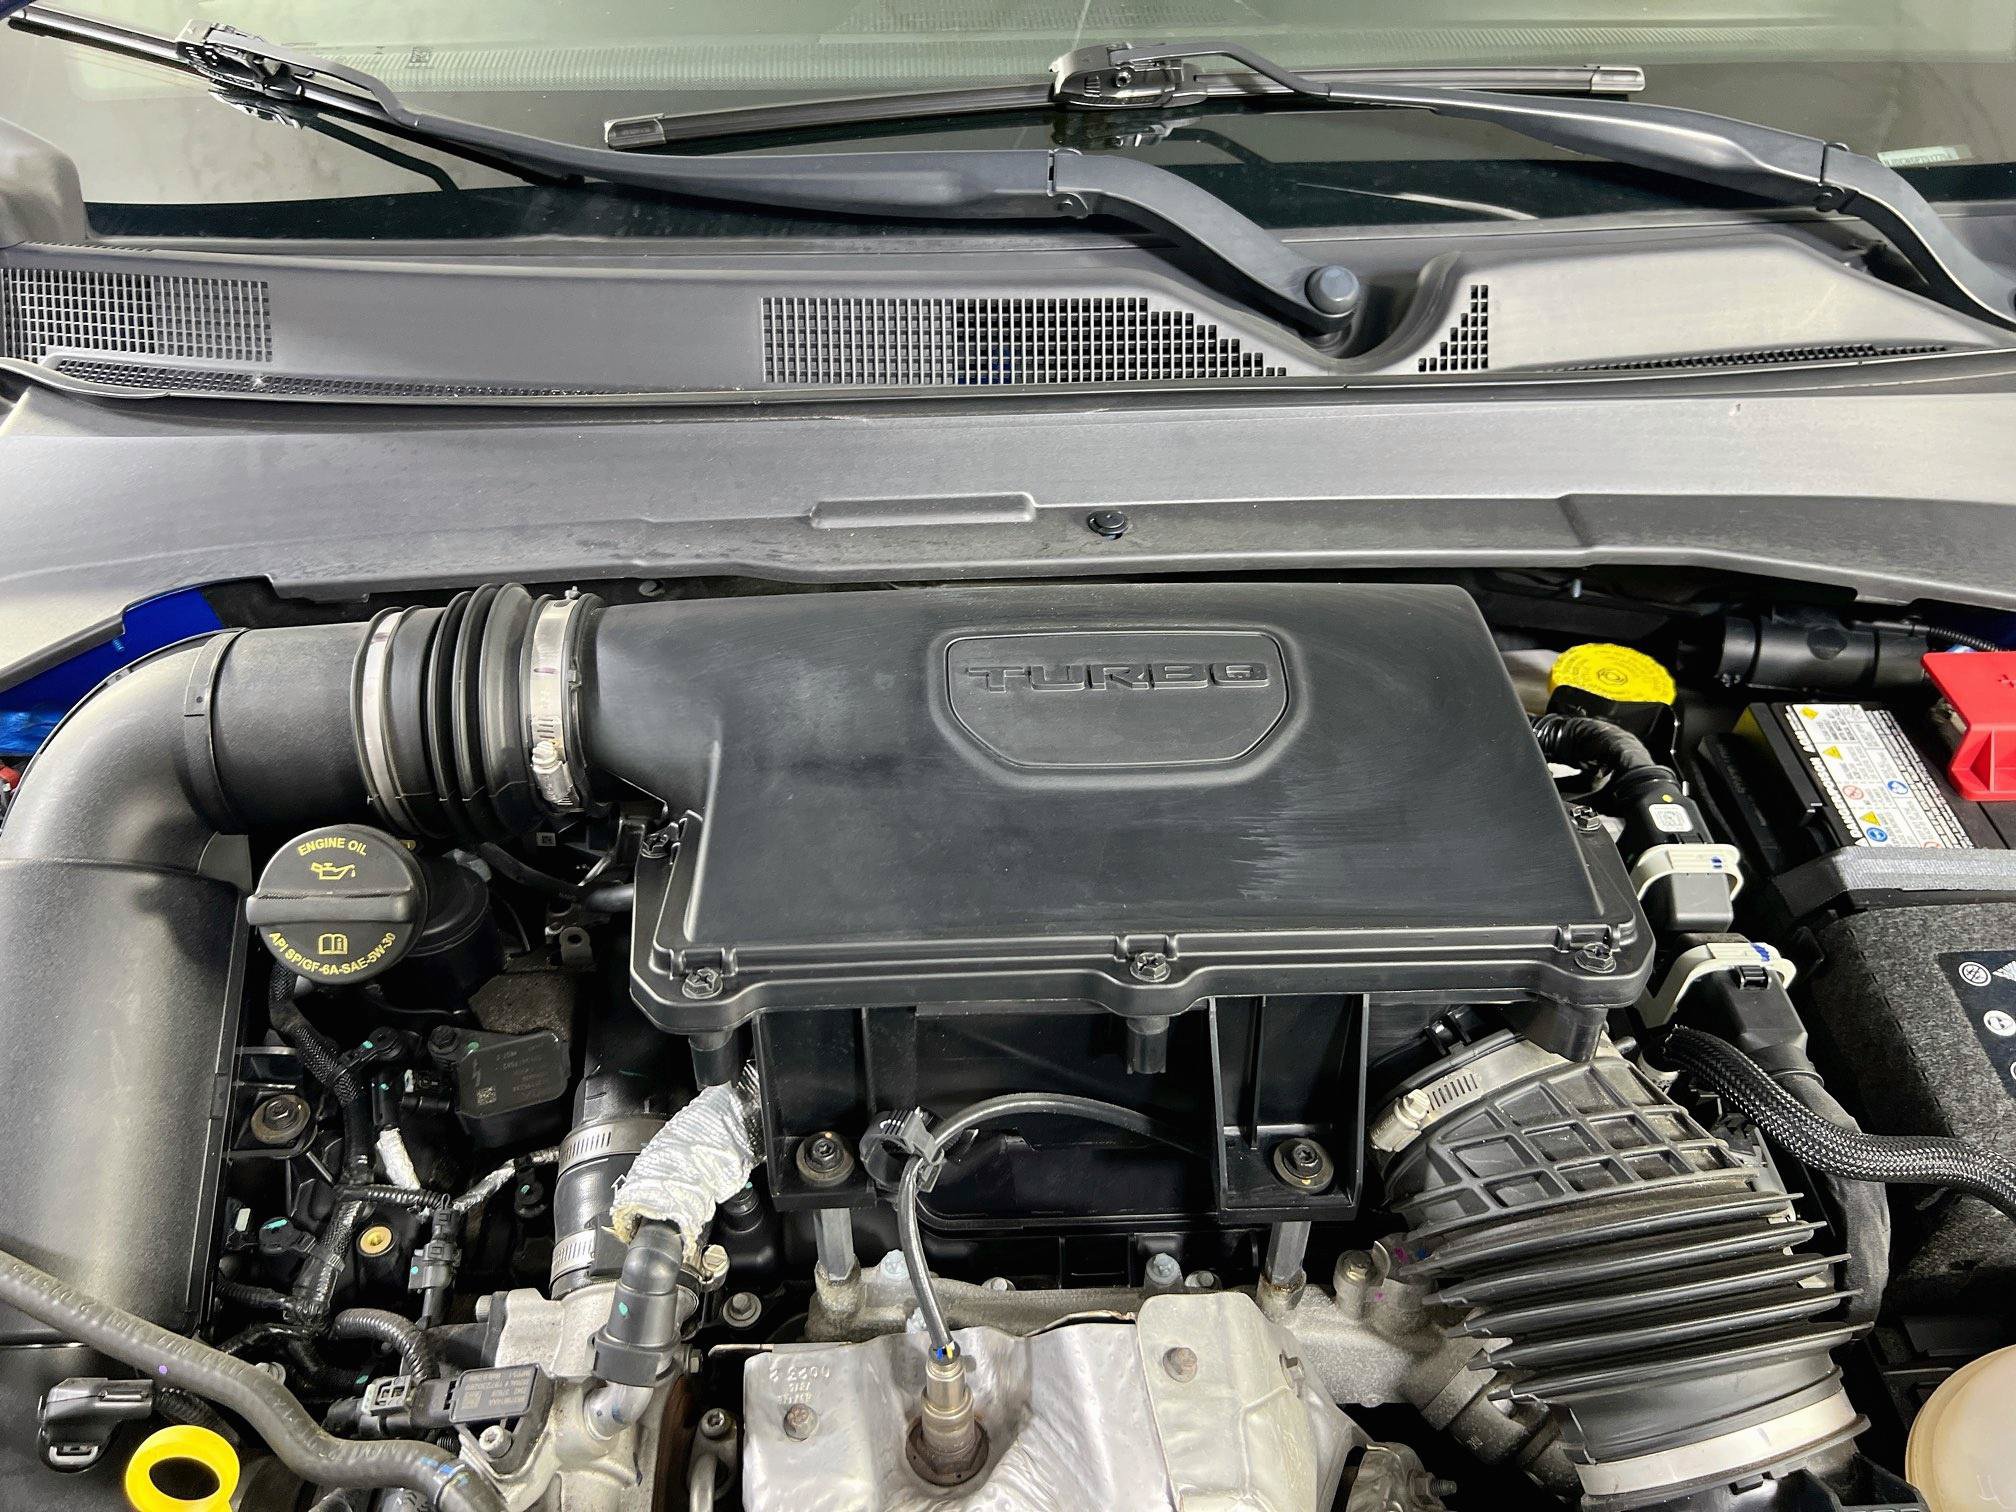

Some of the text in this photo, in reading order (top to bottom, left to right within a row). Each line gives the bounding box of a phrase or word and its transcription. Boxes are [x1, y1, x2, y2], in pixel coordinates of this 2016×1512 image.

[965, 663, 1270, 694] TURBO
[297, 837, 368, 857] ENGINE OIL
[269, 932, 289, 953] API
